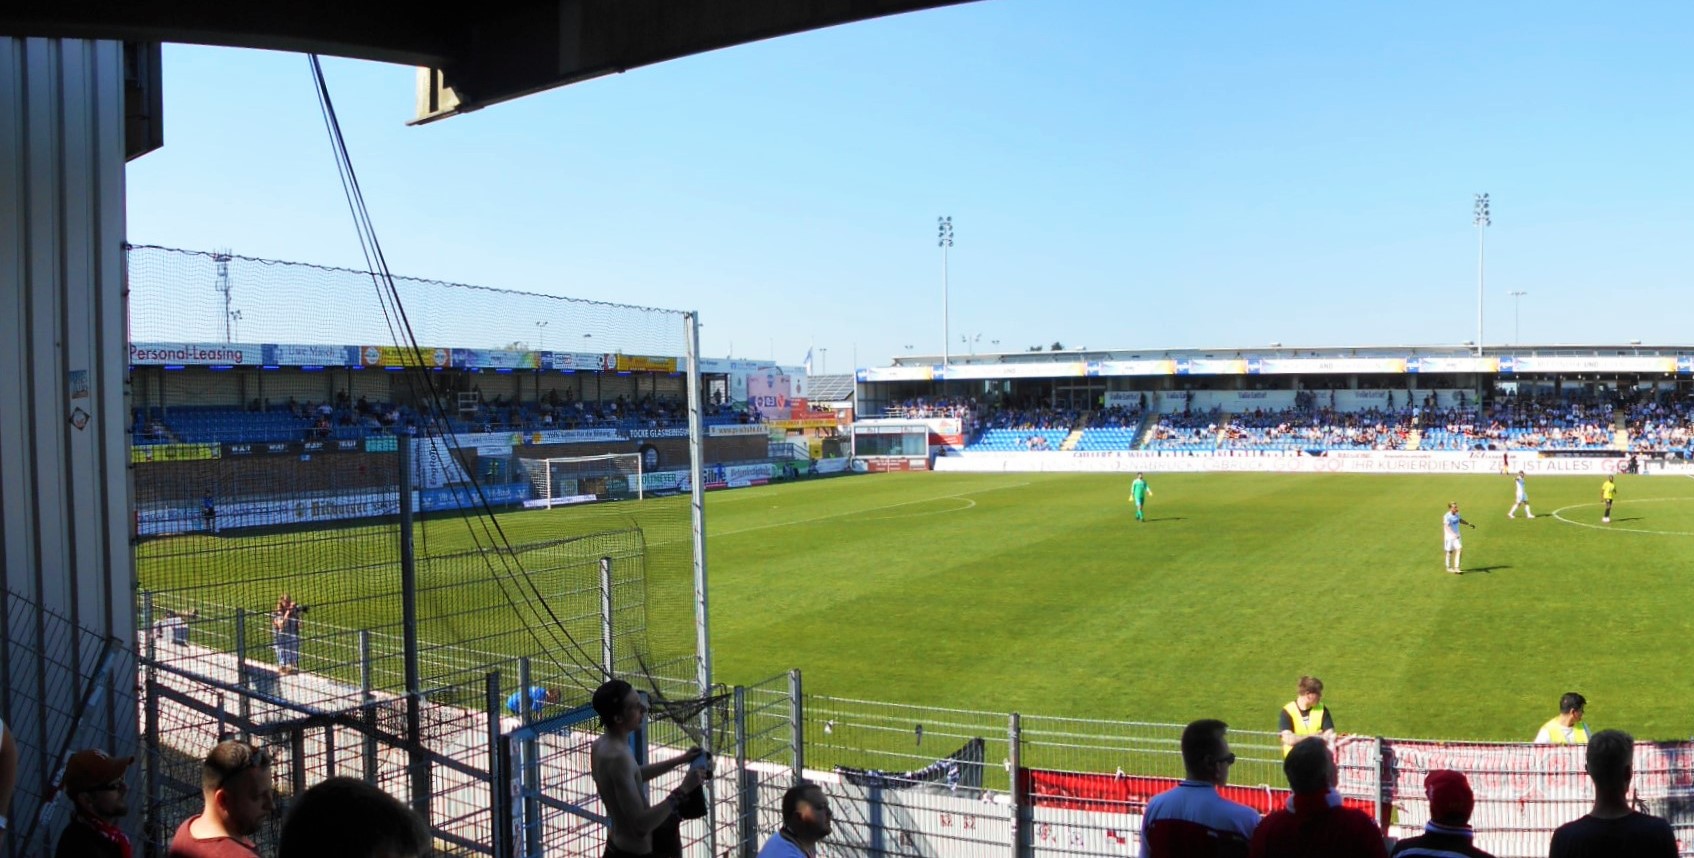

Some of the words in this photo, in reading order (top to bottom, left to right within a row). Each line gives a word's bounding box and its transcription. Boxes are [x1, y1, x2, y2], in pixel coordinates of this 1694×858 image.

[129, 345, 243, 363] Personal-Leasing
[1378, 459, 1477, 471] KURIERDIENST
[1523, 459, 1542, 471] IST
[1547, 459, 1593, 471] ALLES!
